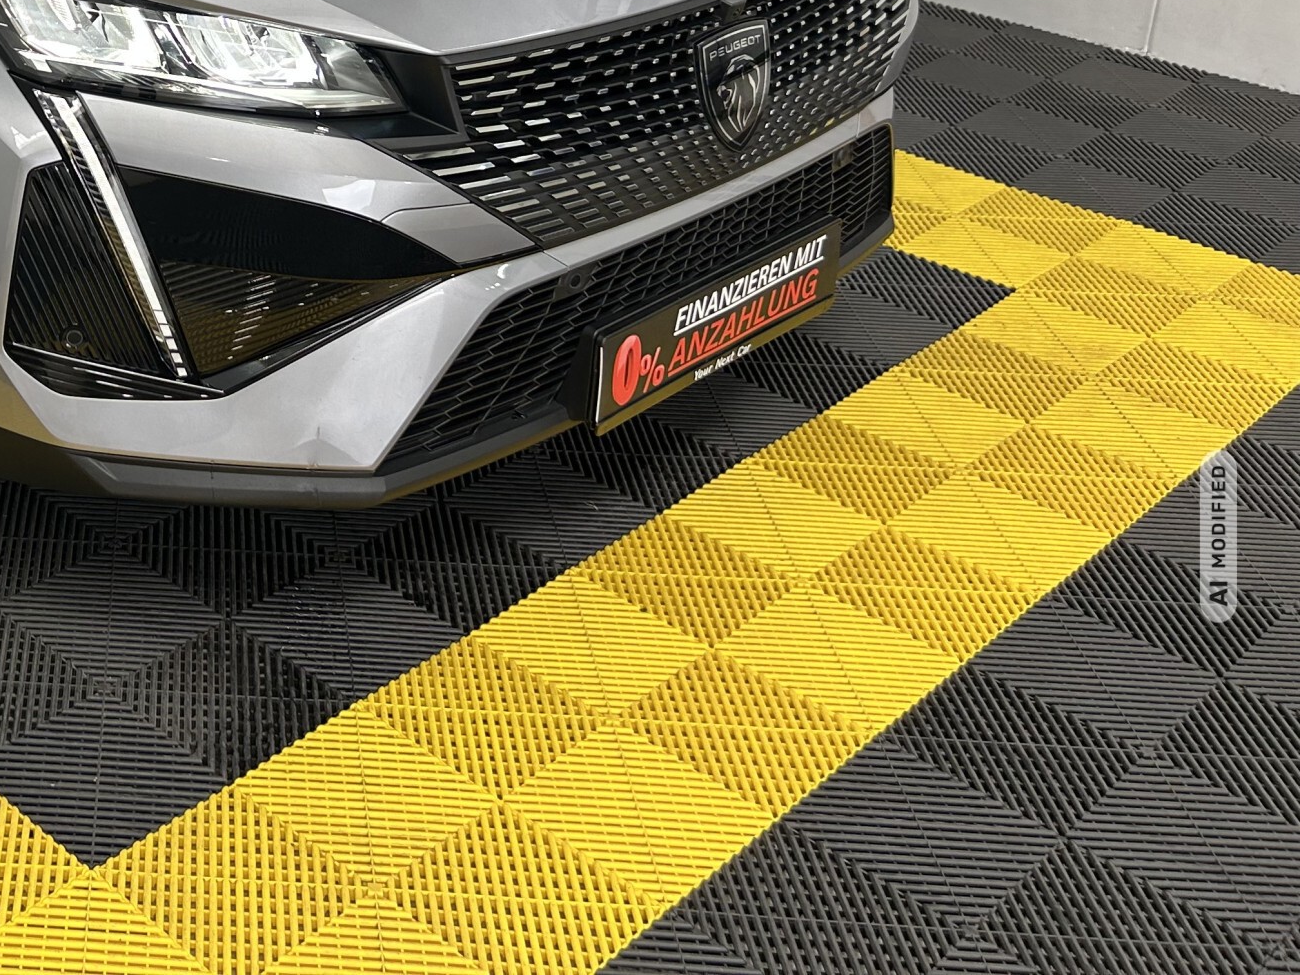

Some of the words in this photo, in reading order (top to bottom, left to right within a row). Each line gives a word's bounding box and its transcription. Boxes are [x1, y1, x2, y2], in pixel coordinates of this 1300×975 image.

[709, 34, 762, 61] PEUGEOT
[674, 252, 793, 332] FINANZIEREN
[794, 235, 827, 270] MIT
[612, 334, 665, 406] 0%
[668, 269, 819, 372] ANZAHLUNG
[694, 363, 713, 381] Your
[715, 353, 735, 369] Next
[737, 343, 751, 356] Car
